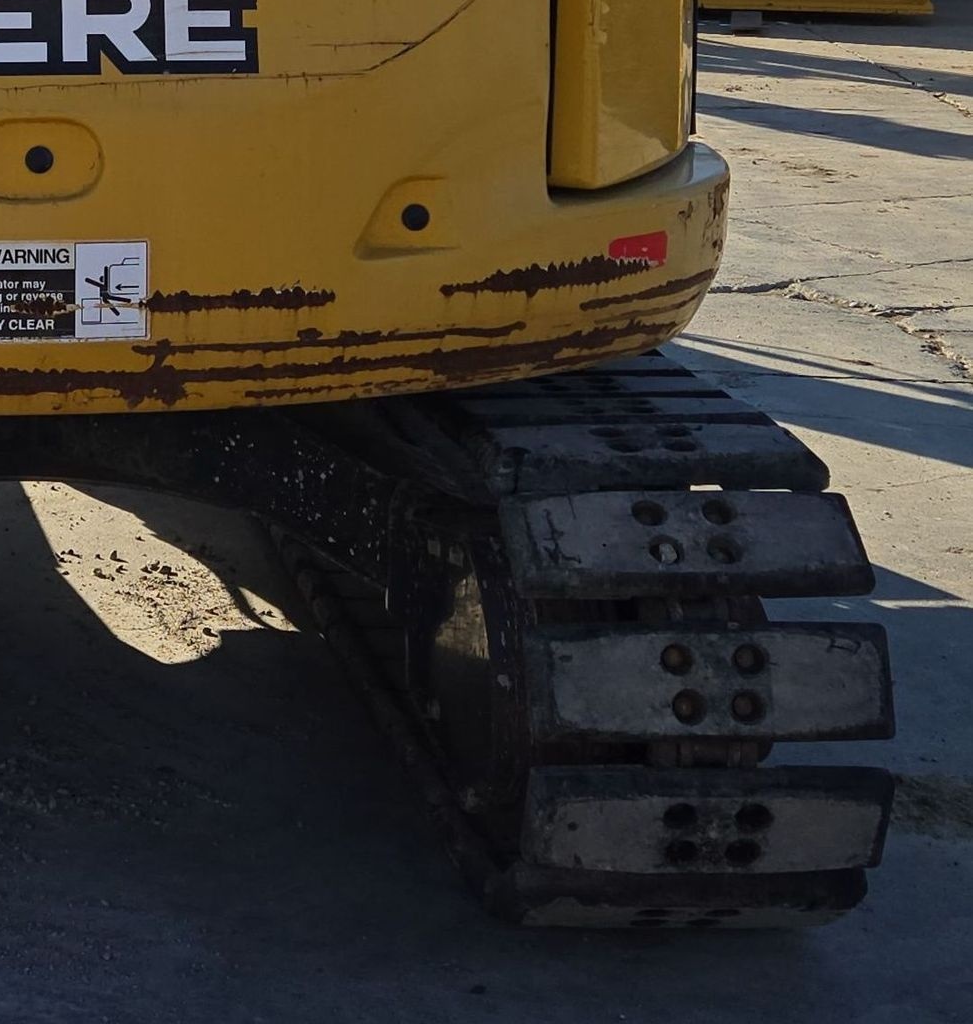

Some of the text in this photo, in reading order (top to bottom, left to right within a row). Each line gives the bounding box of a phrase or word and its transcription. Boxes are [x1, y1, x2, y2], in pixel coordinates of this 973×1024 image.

[22, 280, 46, 291] may
[6, 292, 19, 301] or
[8, 319, 55, 330] CLEAR
